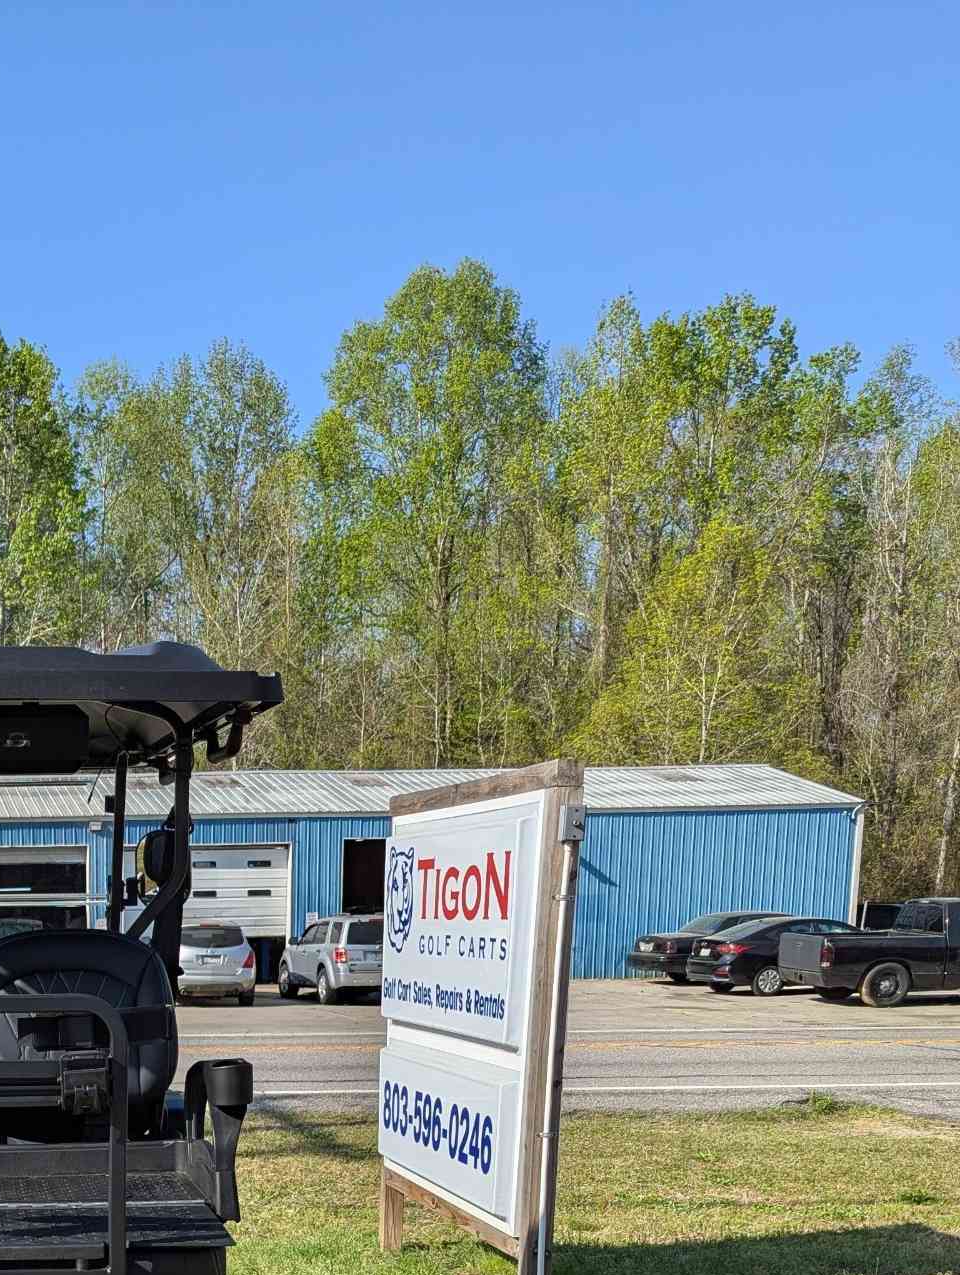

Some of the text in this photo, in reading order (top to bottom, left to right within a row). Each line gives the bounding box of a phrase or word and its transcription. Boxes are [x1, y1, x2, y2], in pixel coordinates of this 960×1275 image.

[417, 850, 512, 921] TIGON
[419, 934, 508, 961] GOLF CARTS
[383, 977, 505, 1021] Golf Cart Sales, Repairs & Rentals
[383, 1080, 494, 1175] 803-596-0246
